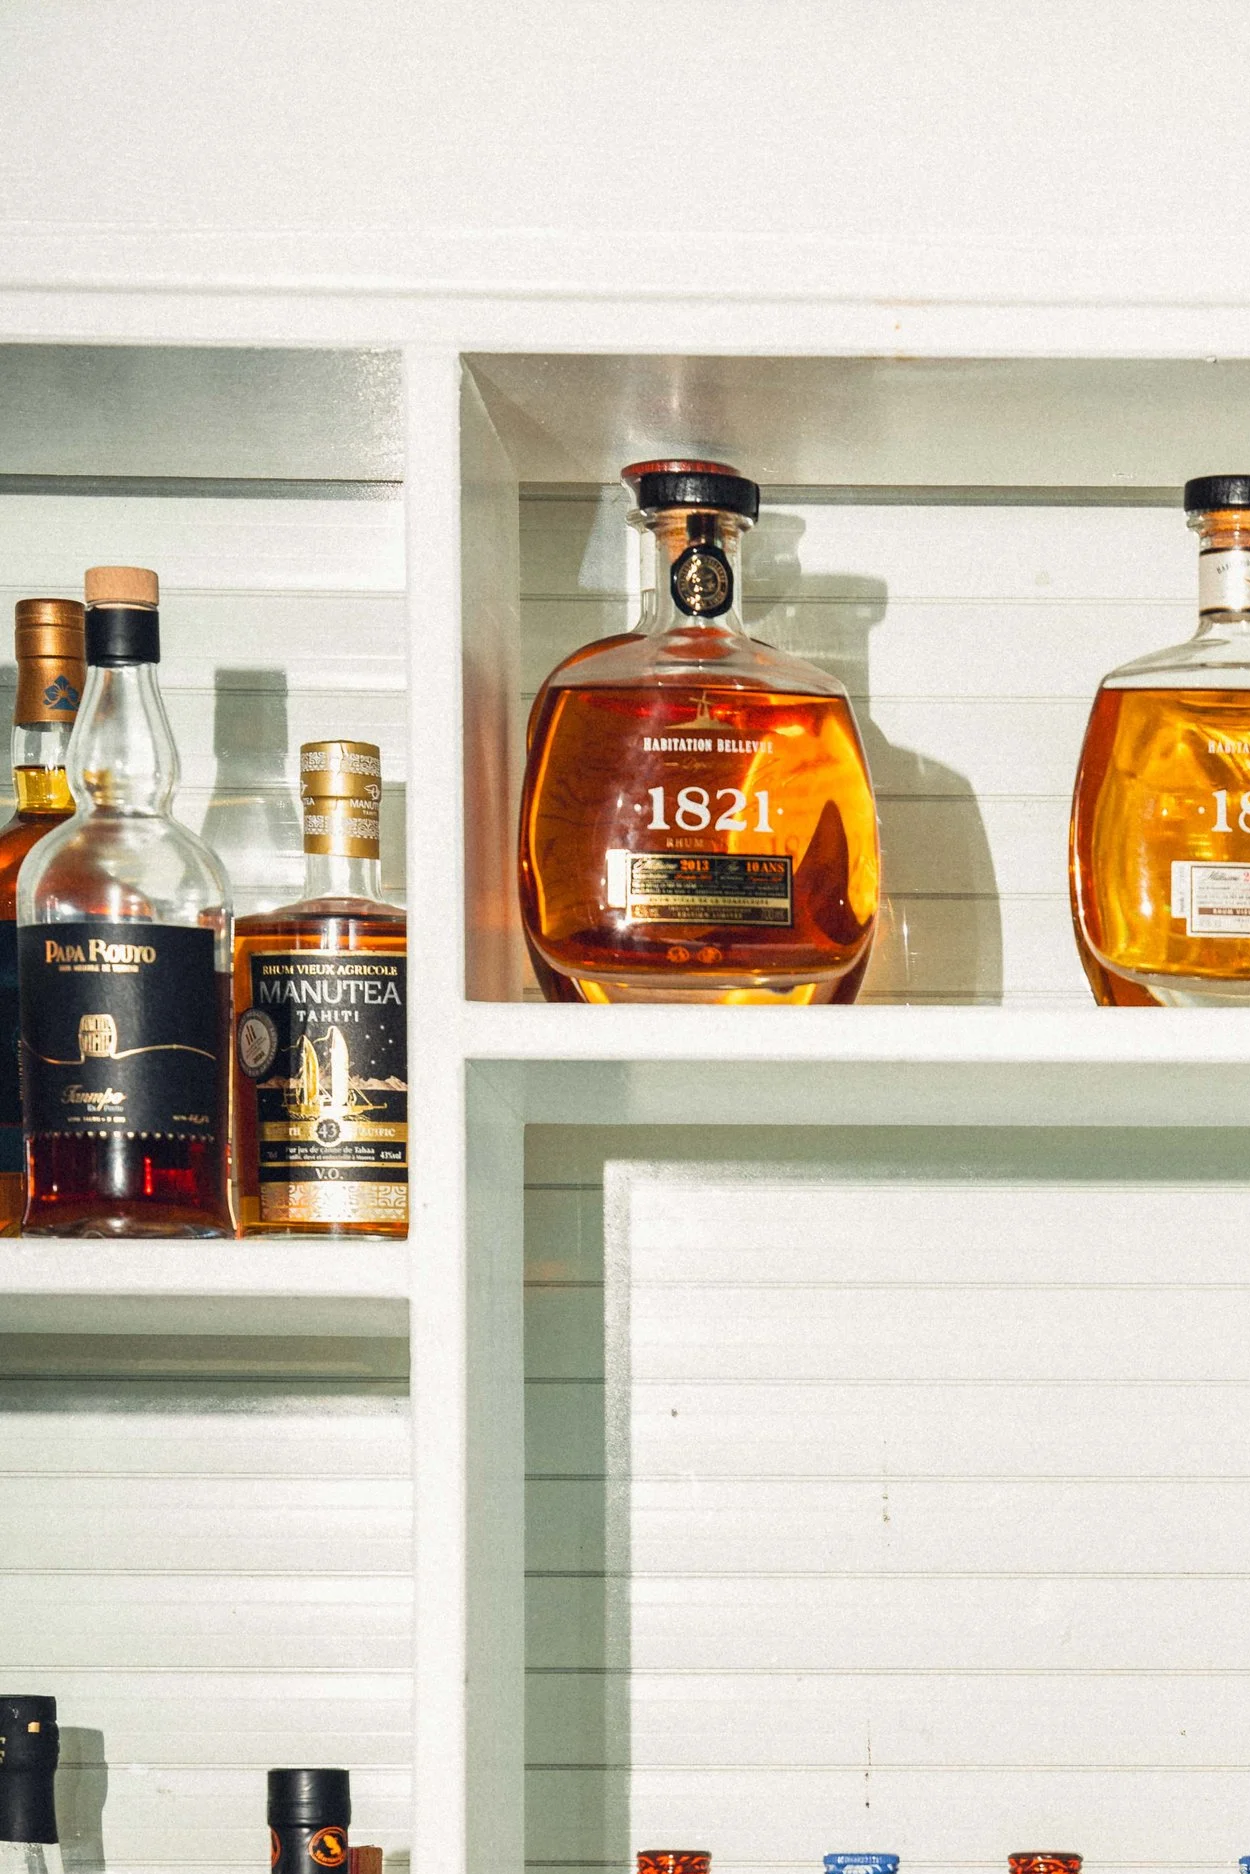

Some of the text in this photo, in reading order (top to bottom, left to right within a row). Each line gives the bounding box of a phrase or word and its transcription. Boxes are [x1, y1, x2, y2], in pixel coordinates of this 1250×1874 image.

[643, 737, 712, 752] HABITATION
[647, 786, 774, 832] 1821
[761, 862, 785, 873] ANS
[297, 965, 336, 976] VIEUX
[337, 965, 398, 976] AGRICOLE
[259, 980, 402, 1005] MANUTEA
[296, 1010, 359, 1022] TAHITI
[318, 1124, 338, 1137] 43
